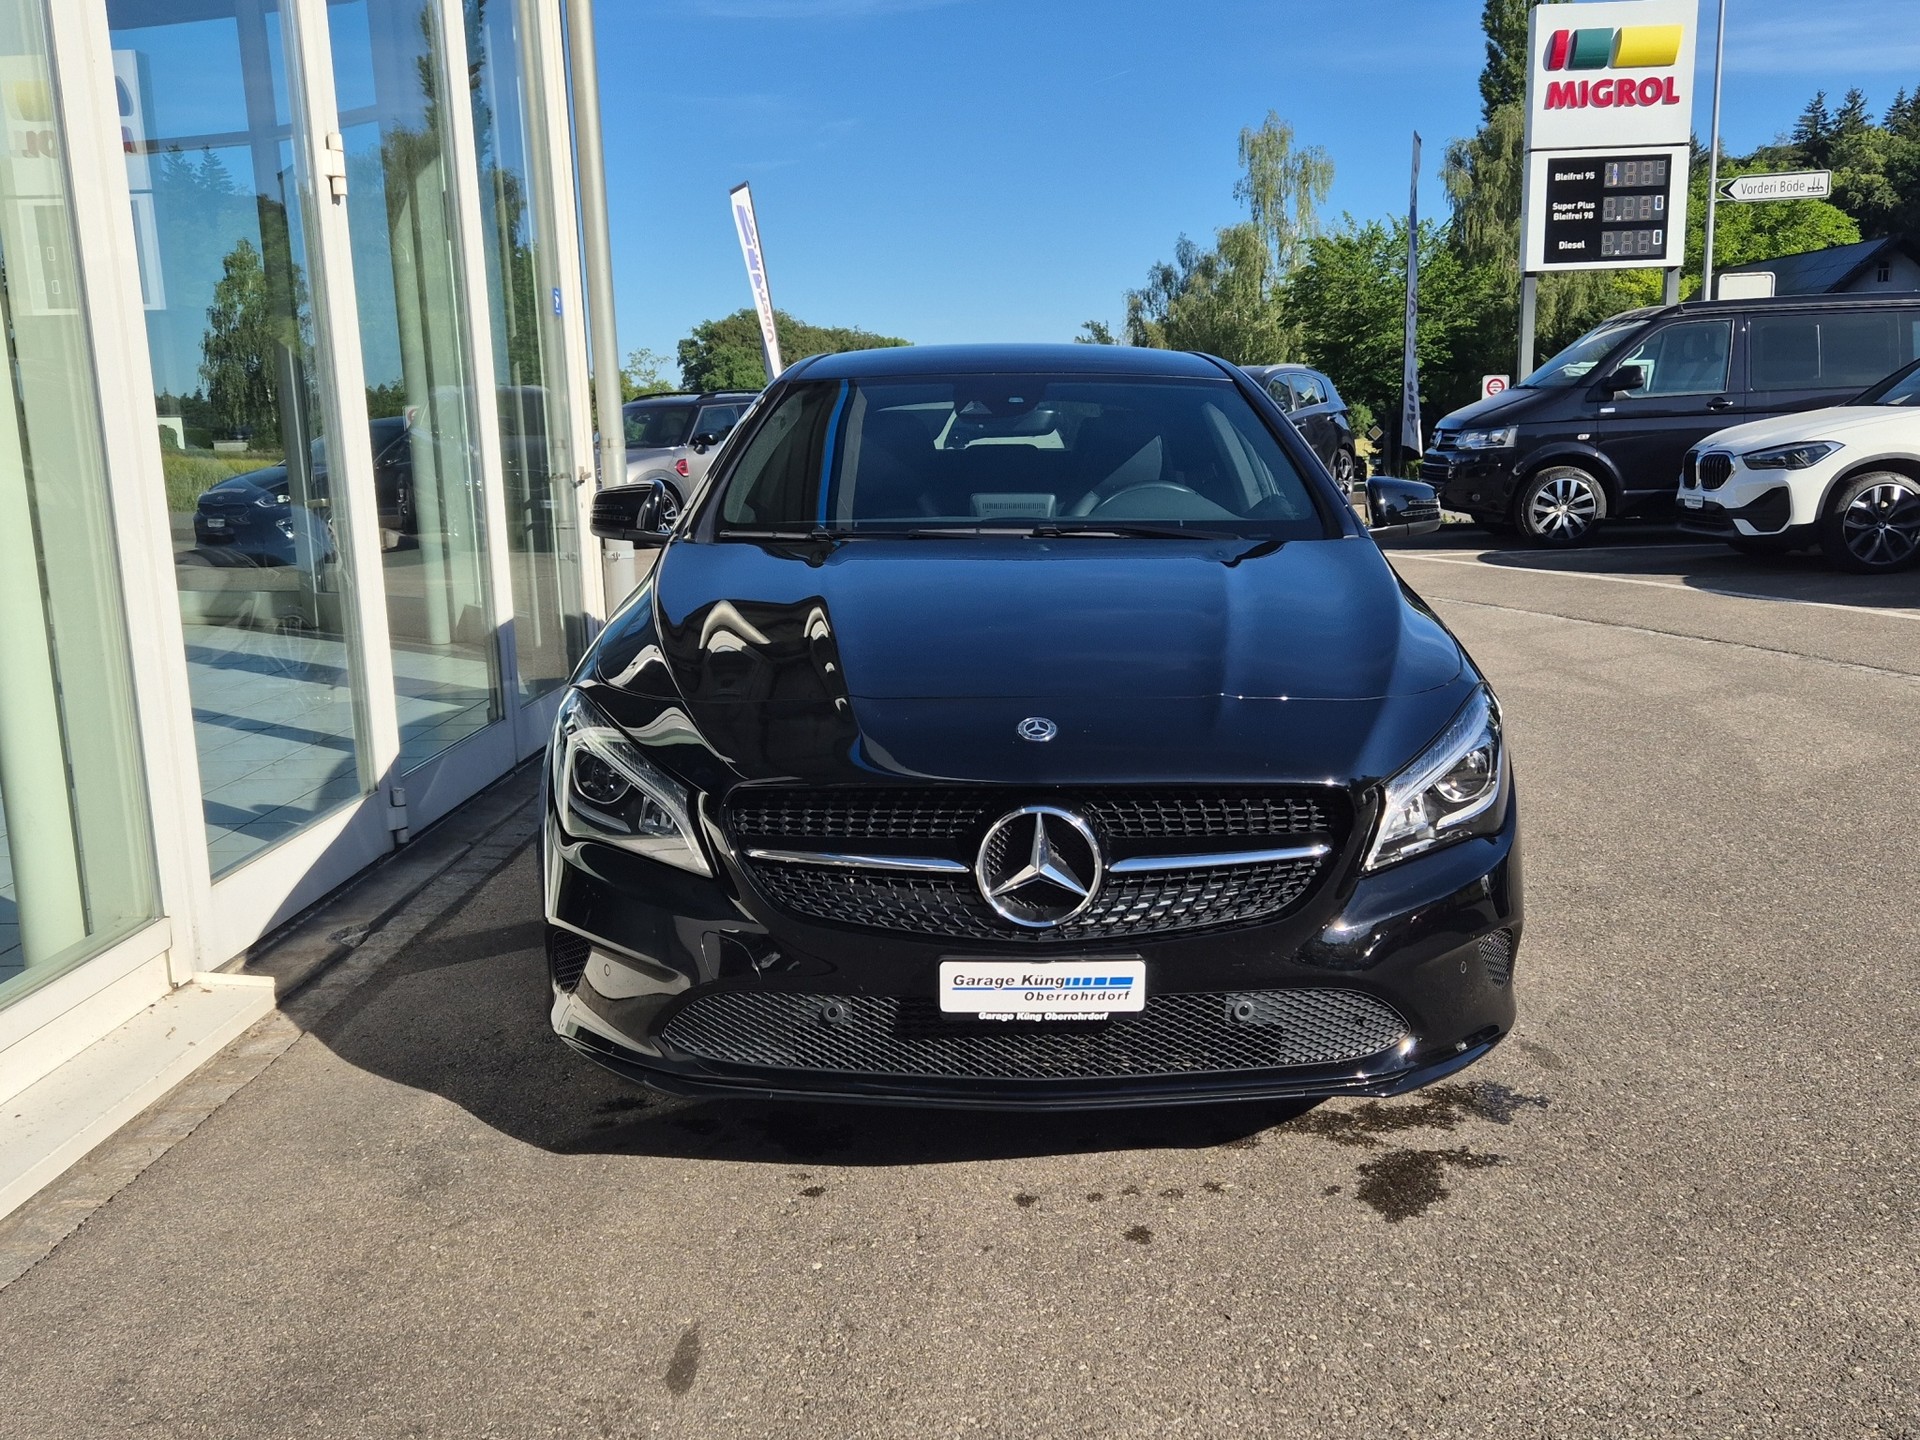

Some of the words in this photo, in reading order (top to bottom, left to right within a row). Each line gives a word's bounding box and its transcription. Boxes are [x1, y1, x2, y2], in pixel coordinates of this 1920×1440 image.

[1544, 77, 1680, 110] MIGROL
[1555, 173, 1584, 181] Bleifrei
[1585, 172, 1595, 180] 95
[1741, 181, 1777, 195] Vorderi
[1780, 179, 1805, 192] Böde
[1552, 202, 1575, 211] Super
[1553, 212, 1582, 221] Bleifrei
[1583, 211, 1594, 219] 98
[1558, 240, 1585, 250] Diesel
[953, 974, 1015, 988] Garage
[1021, 974, 1065, 989] Küng
[1024, 990, 1131, 1001] Oberrohrdorf
[978, 1012, 1014, 1022] Garage
[1016, 1012, 1042, 1022] Küng
[1044, 1012, 1109, 1021] Oberrohrdorf
